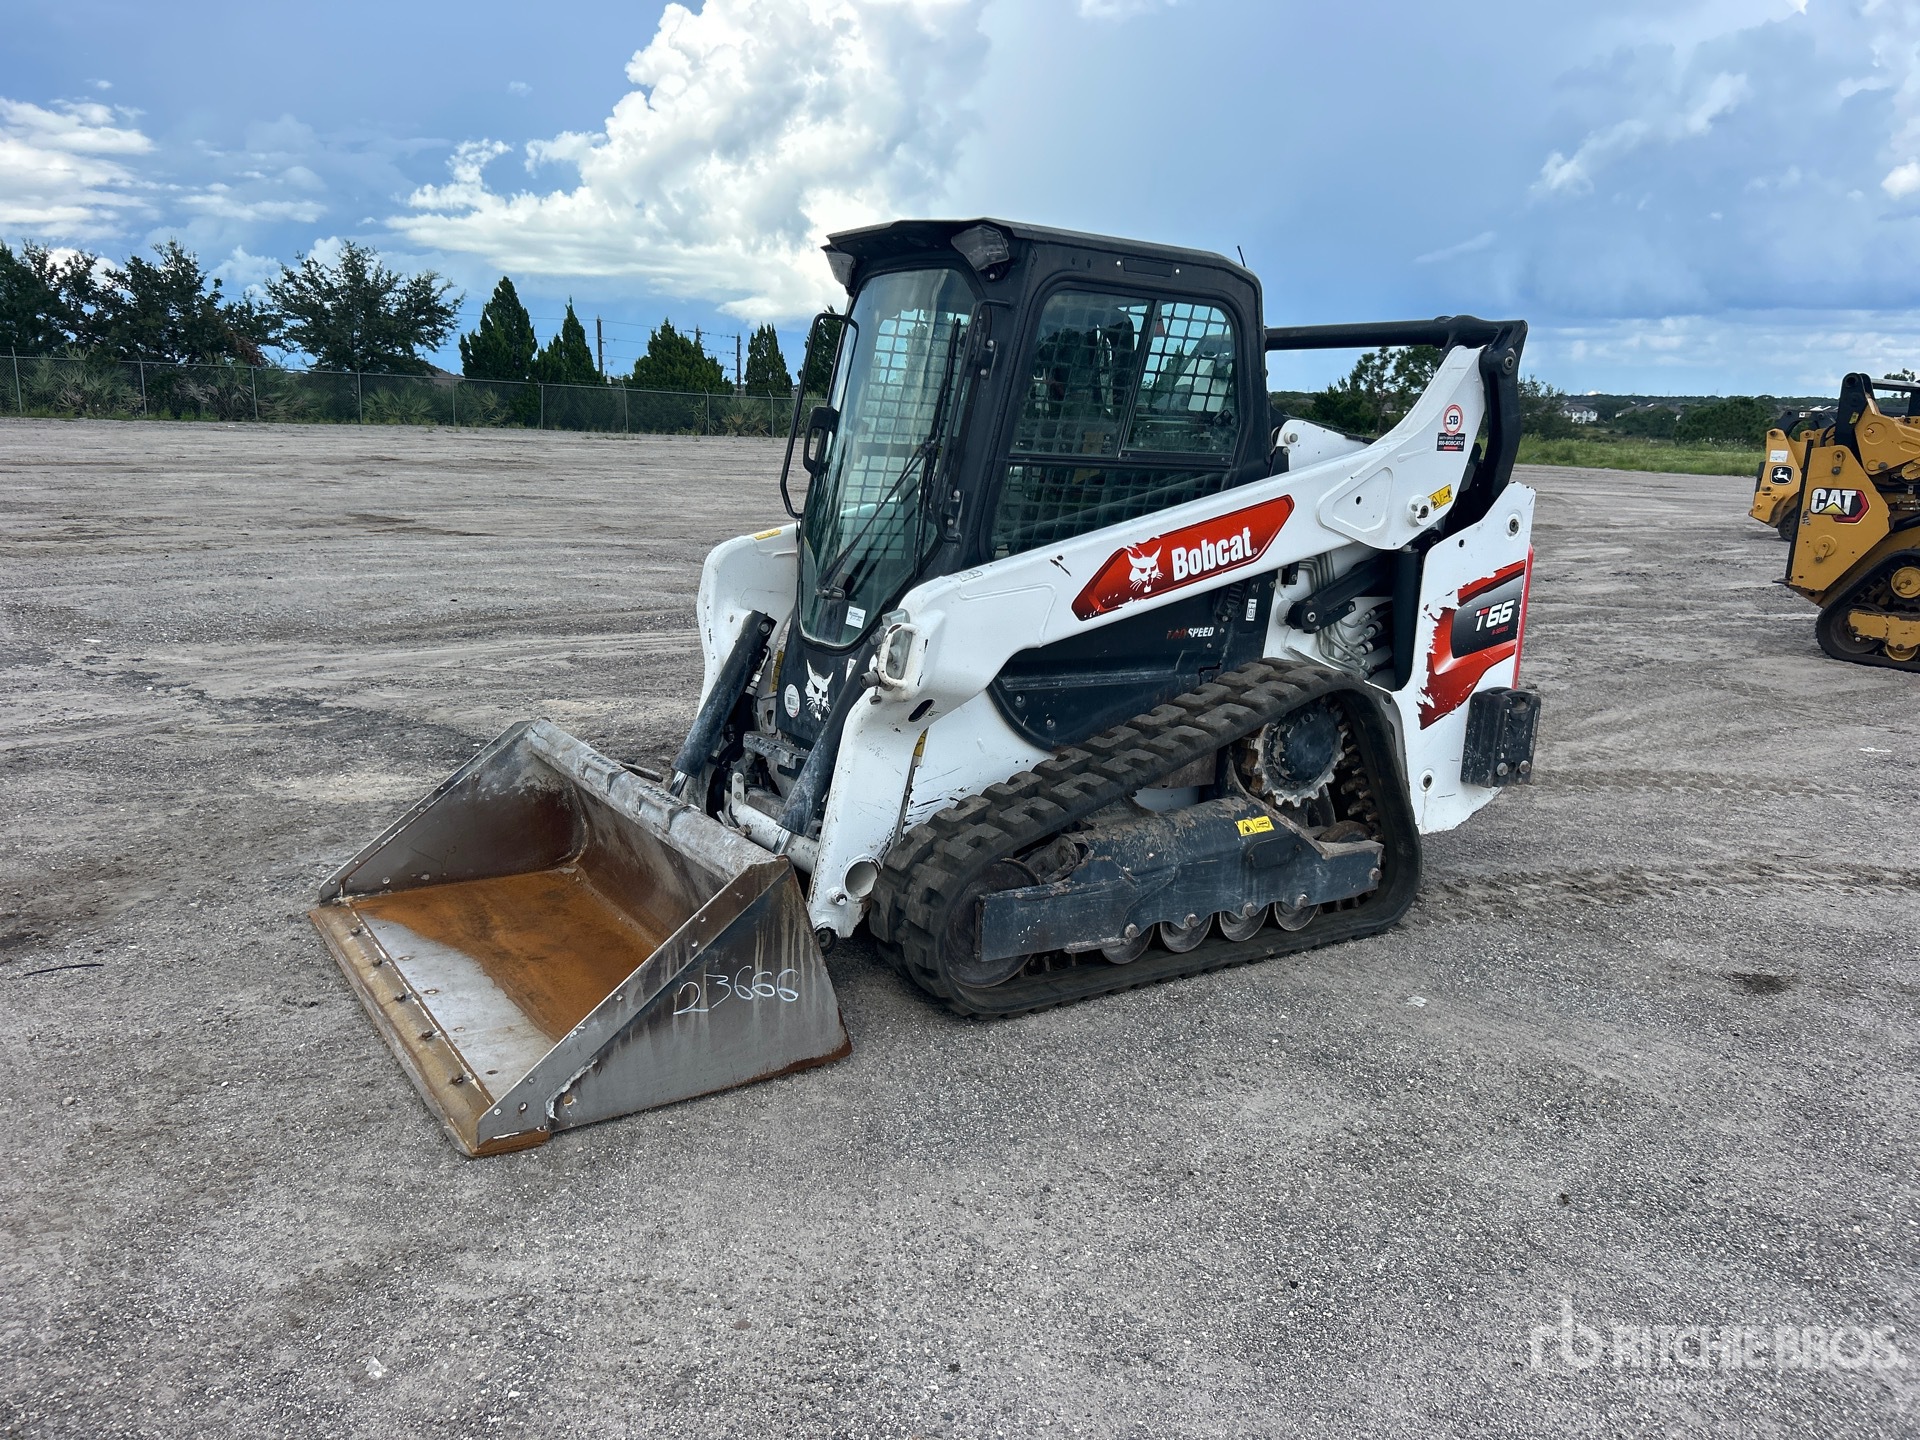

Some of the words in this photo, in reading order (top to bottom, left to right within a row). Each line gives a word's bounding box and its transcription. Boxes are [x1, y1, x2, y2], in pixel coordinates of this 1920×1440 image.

[1810, 488, 1857, 516] CAT
[1171, 526, 1252, 582] Bobcat
[1187, 626, 1215, 638] SPEED
[1475, 599, 1516, 632] T66
[672, 965, 800, 1016] 23666
